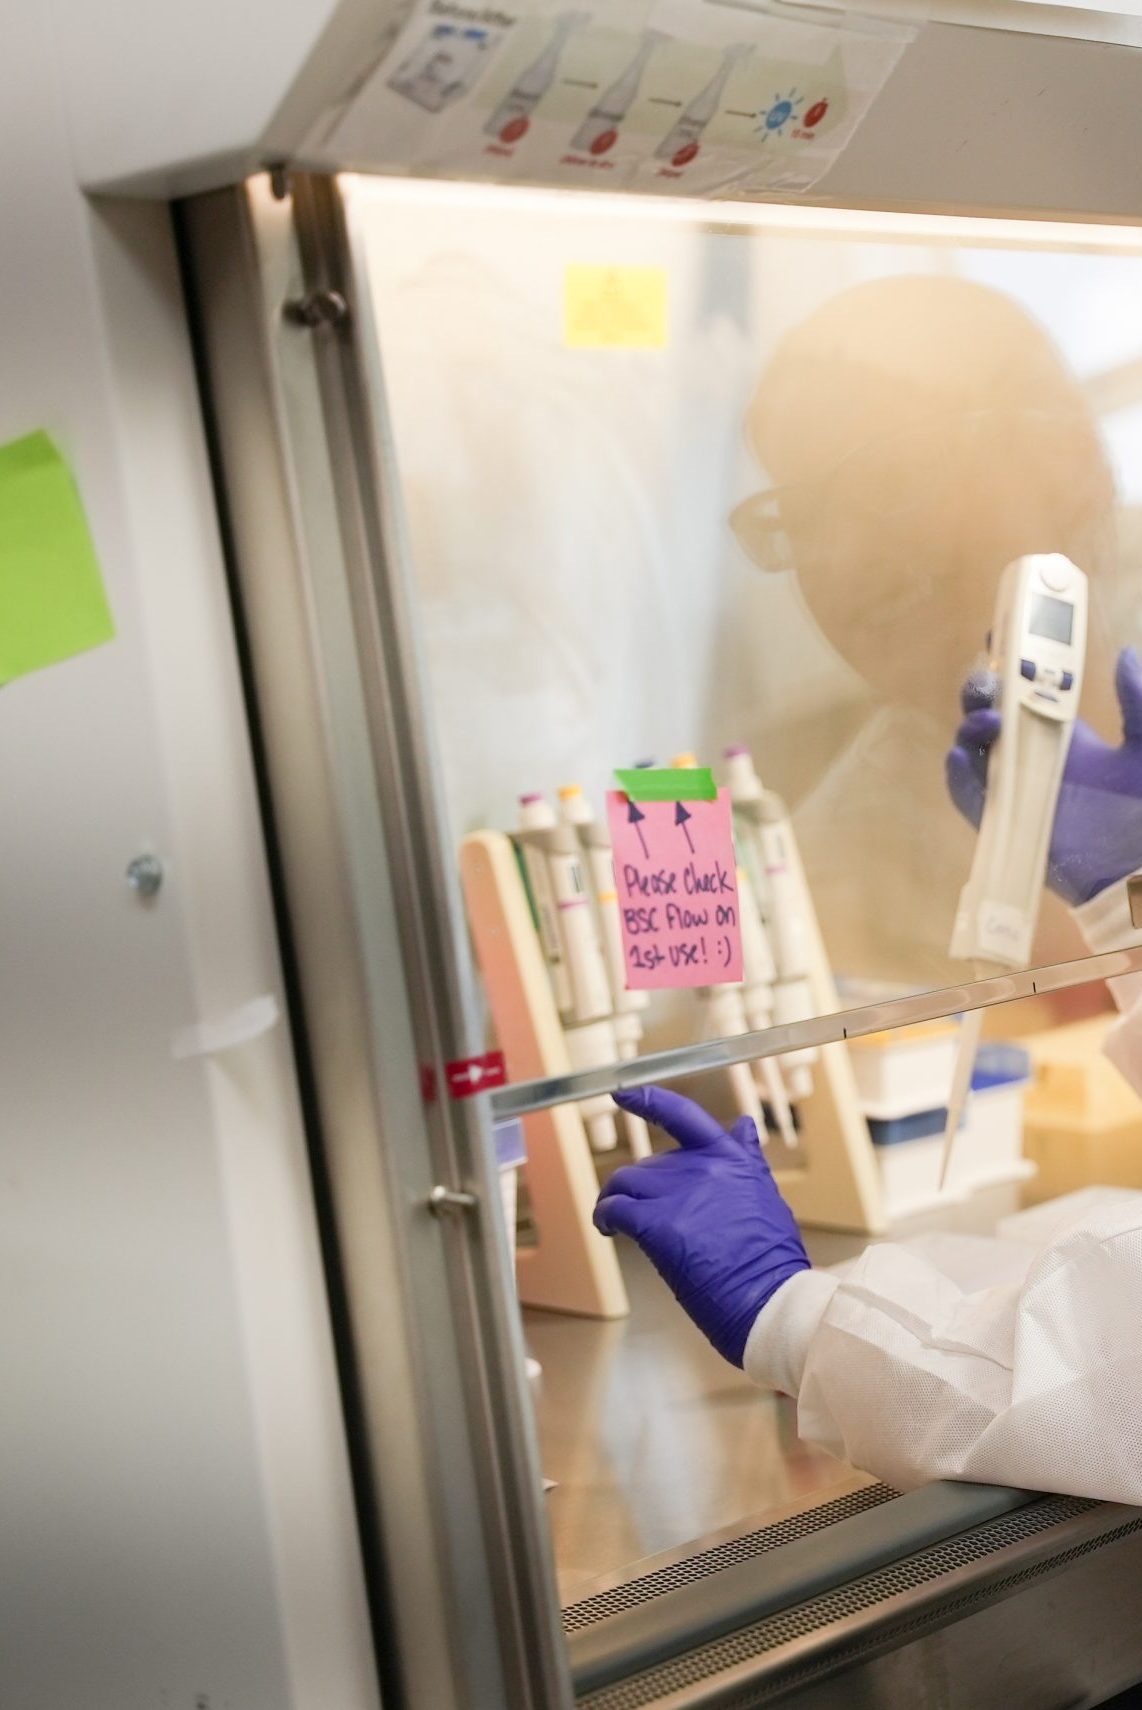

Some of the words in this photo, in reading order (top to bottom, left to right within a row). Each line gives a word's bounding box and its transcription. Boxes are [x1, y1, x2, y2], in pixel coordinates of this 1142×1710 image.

[624, 864, 677, 897] Please
[624, 907, 659, 935] BSC
[630, 945, 665, 969] 1st
